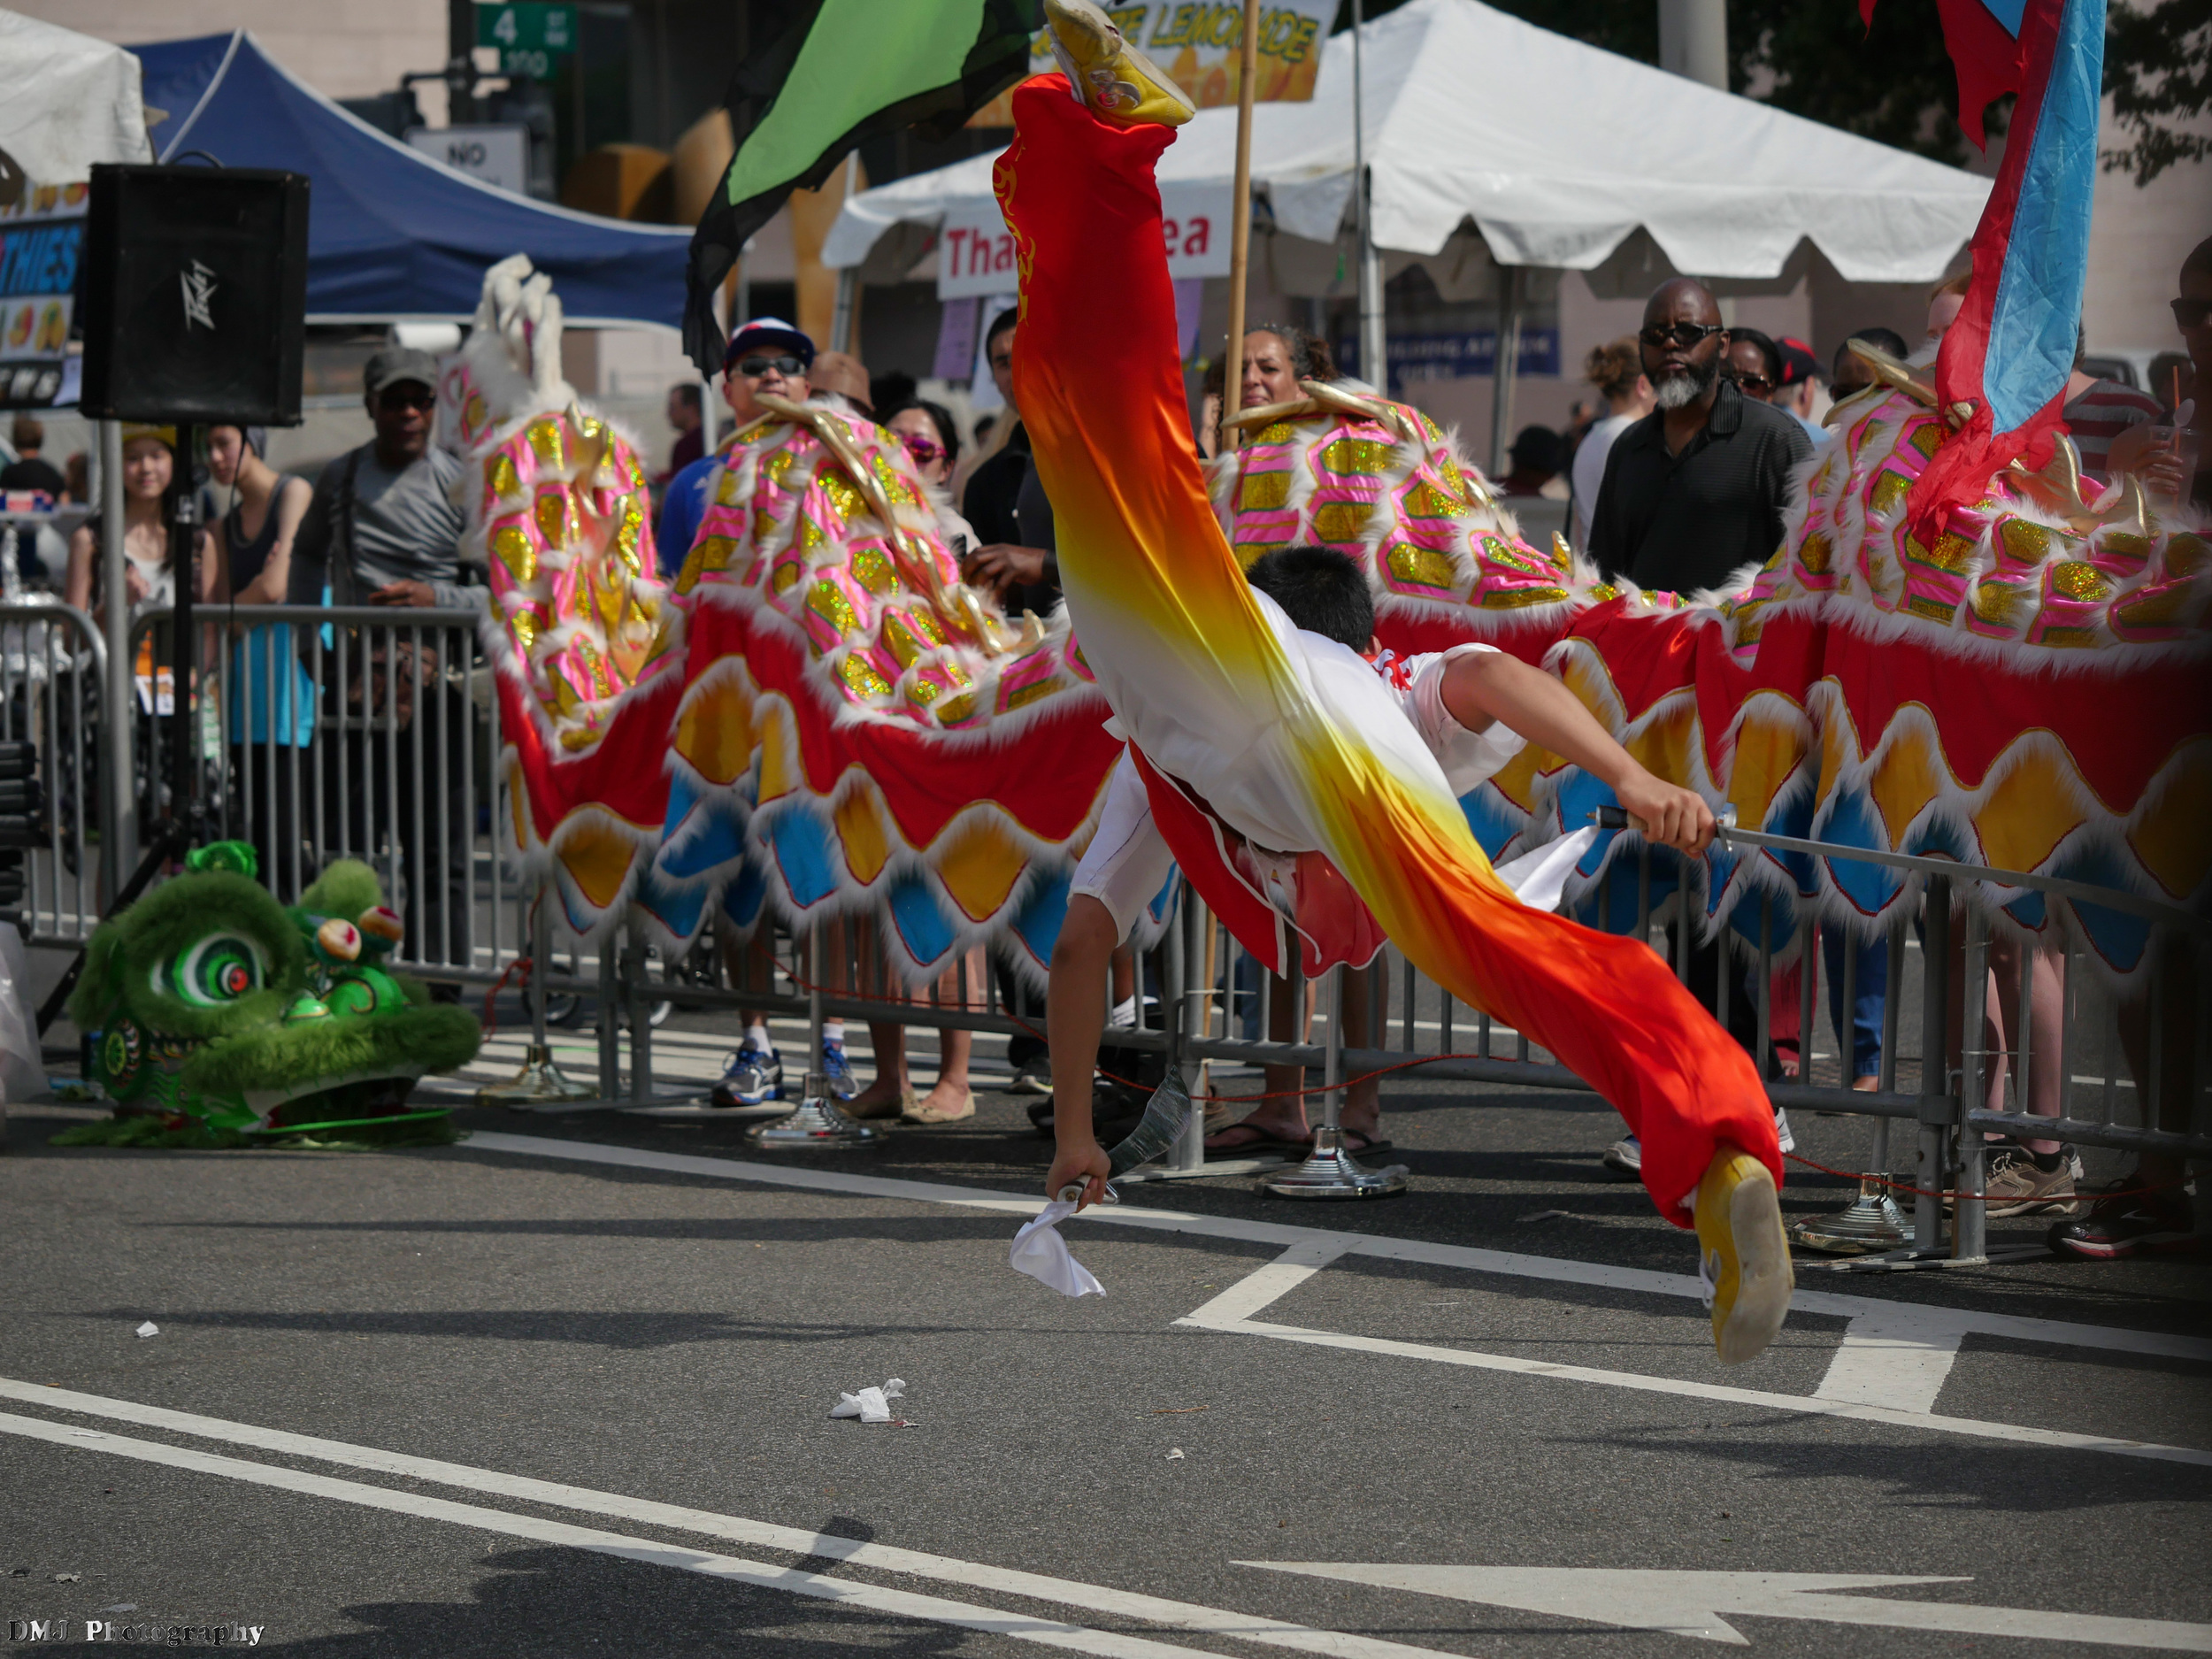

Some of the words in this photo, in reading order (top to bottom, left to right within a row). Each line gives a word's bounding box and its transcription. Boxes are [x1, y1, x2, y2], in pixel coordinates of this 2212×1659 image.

[493, 8, 518, 44] 4
[448, 142, 486, 166] NO
[0, 225, 81, 294] THIES
[946, 227, 1016, 279] Tha
[1162, 217, 1210, 257] ea
